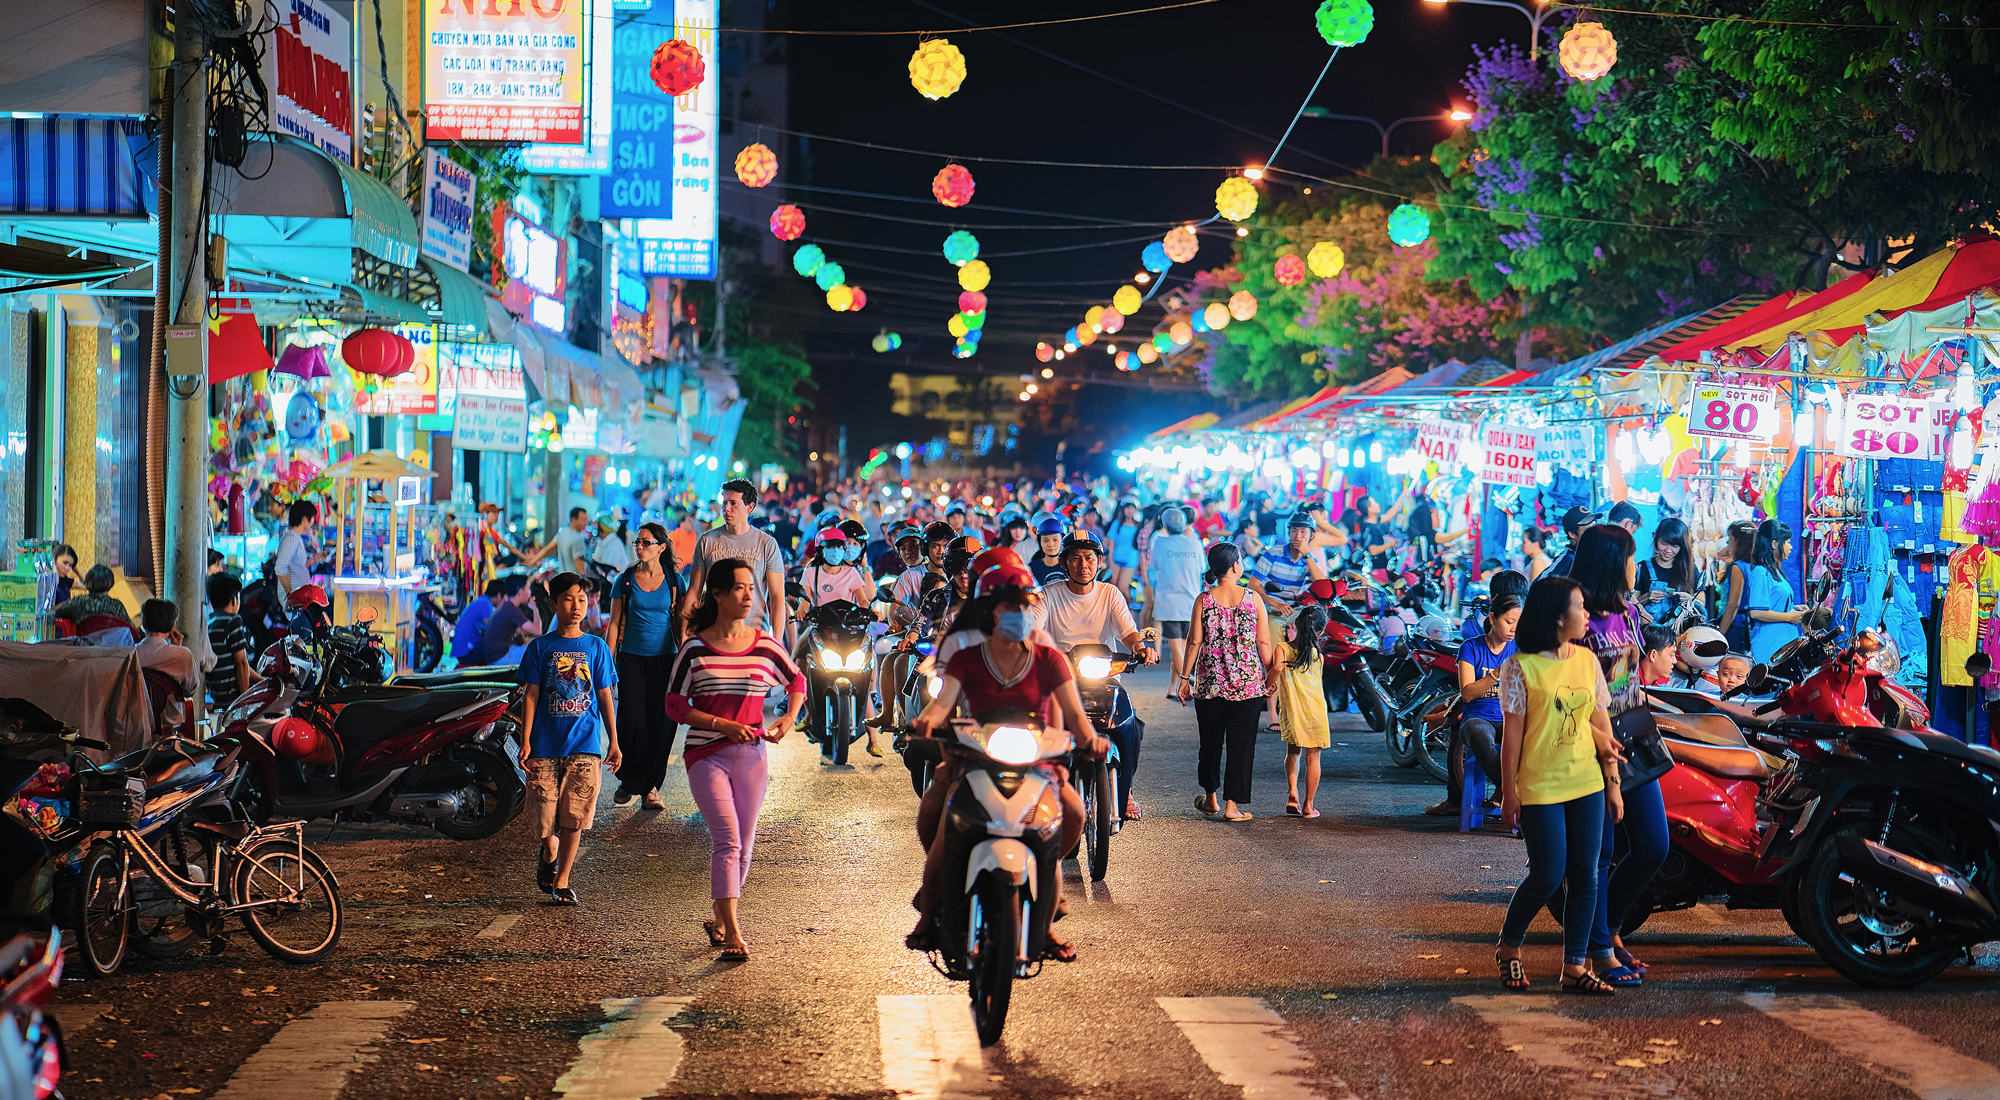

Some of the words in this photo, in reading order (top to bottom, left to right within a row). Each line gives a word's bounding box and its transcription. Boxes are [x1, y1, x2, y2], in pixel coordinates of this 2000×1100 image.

[472, 33, 491, 46] MUA
[533, 35, 548, 48] GIA
[1705, 400, 1758, 433] 80
[1850, 428, 1919, 454] 80
[1486, 450, 1534, 471] 160K
